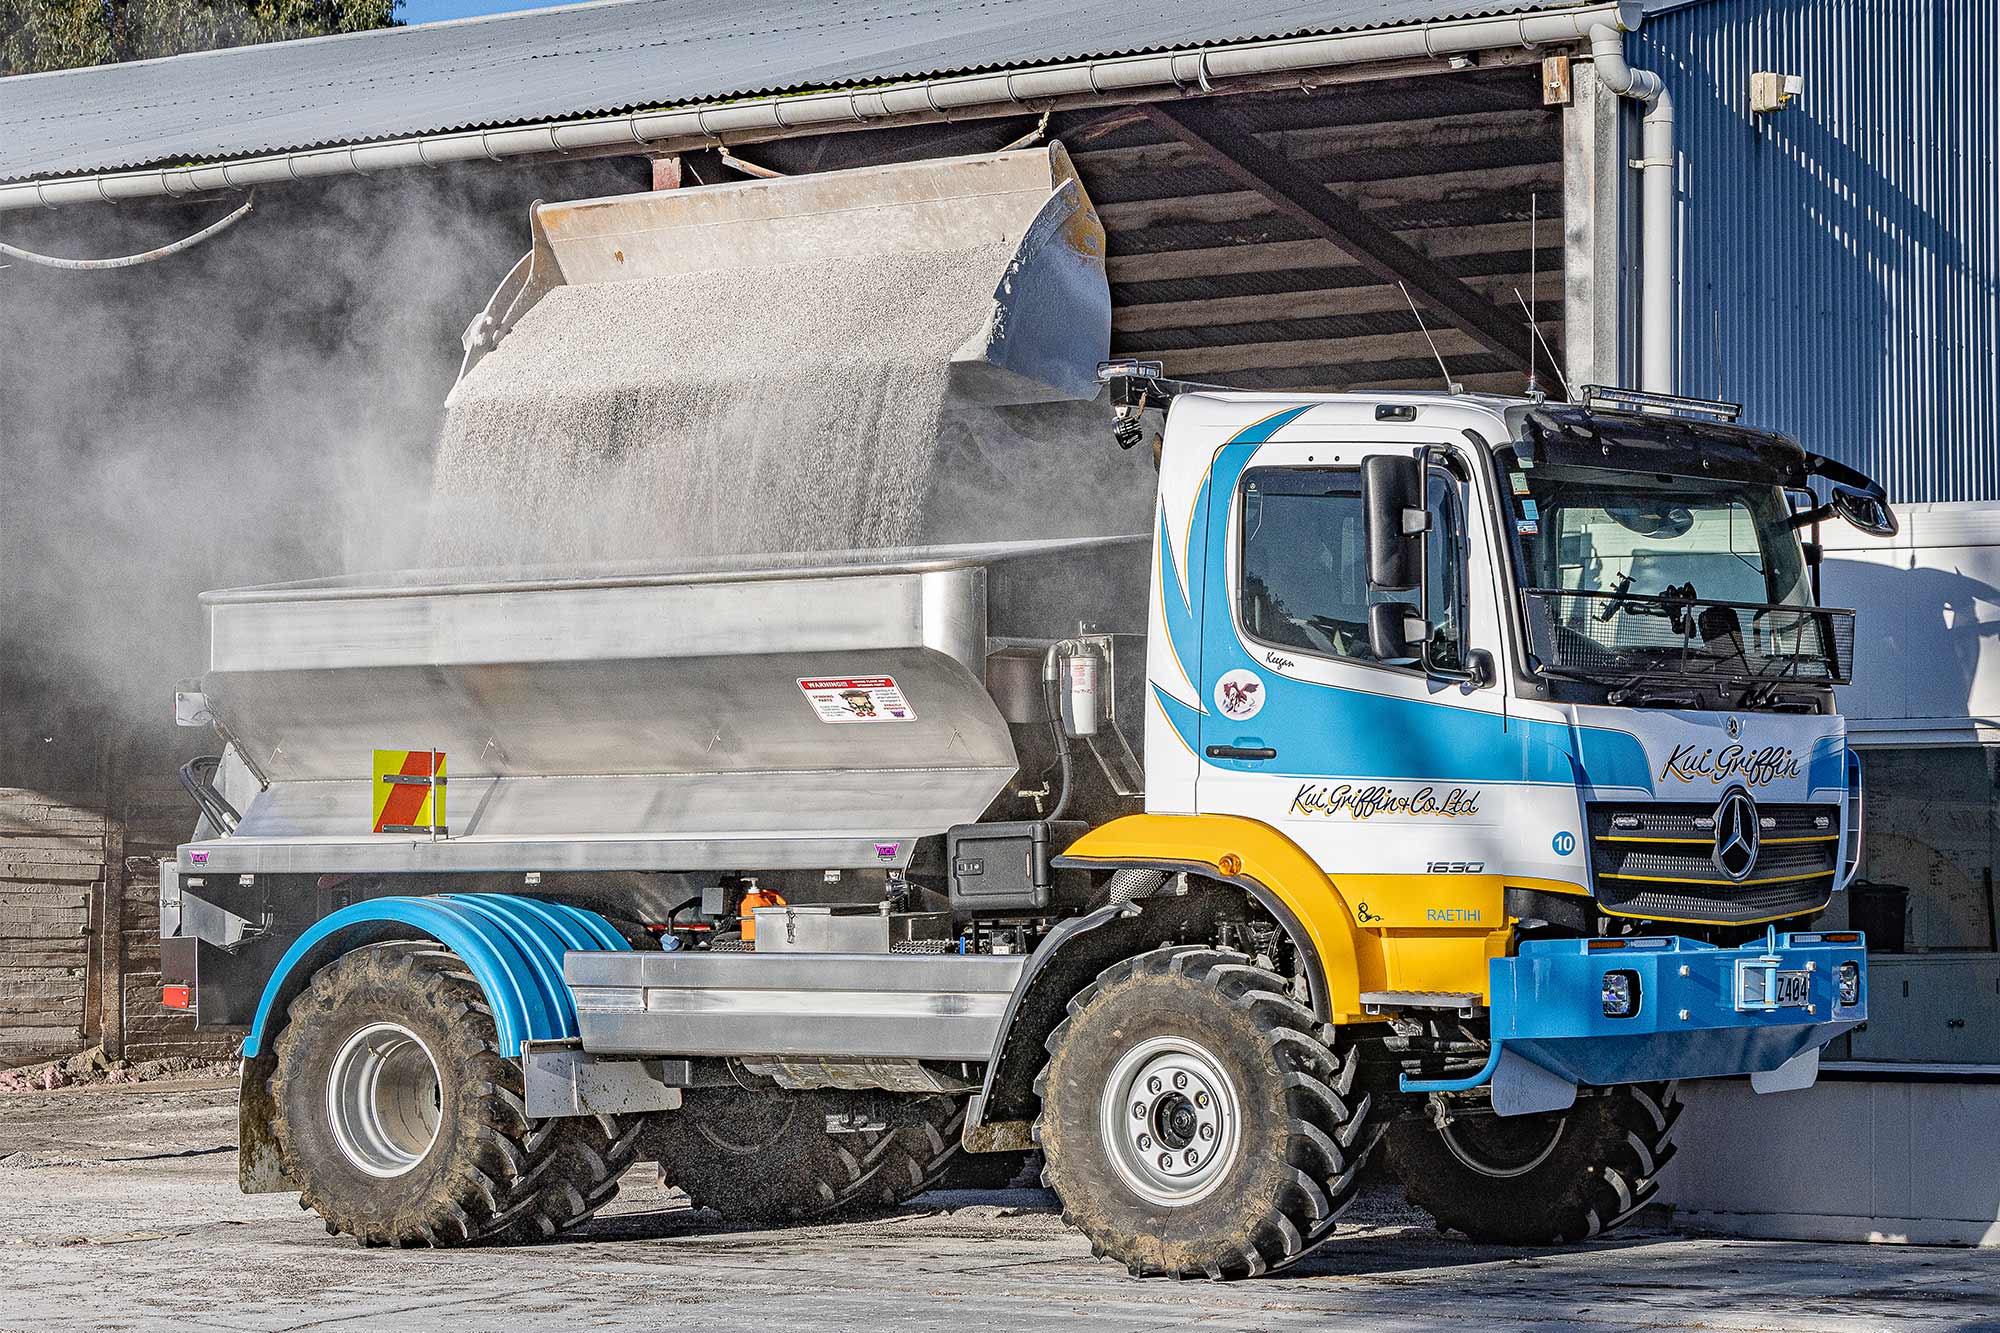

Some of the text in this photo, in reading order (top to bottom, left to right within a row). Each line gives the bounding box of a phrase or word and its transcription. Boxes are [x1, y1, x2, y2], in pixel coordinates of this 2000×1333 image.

[1265, 651, 1295, 671] Keegan
[1711, 744, 1801, 786] Griffin
[1326, 784, 1398, 819] Griffin
[1410, 787, 1440, 815] Co.
[1439, 788, 1480, 816] Ltd.
[1554, 835, 1573, 852] 10
[1426, 861, 1485, 874] 1630
[1426, 908, 1481, 922] RAETIHI
